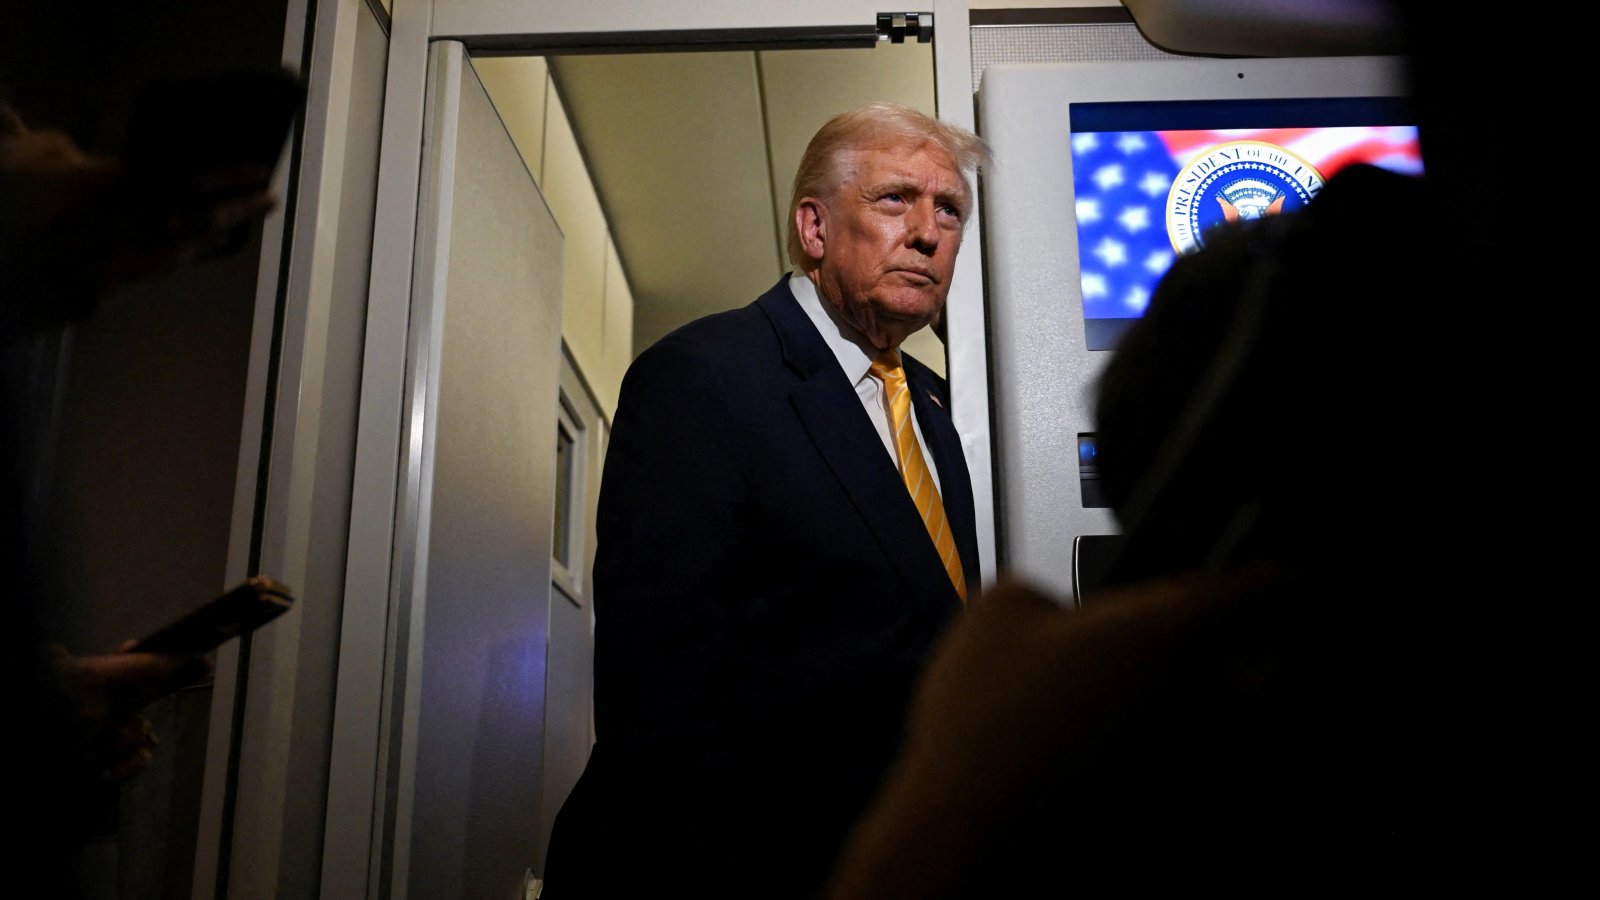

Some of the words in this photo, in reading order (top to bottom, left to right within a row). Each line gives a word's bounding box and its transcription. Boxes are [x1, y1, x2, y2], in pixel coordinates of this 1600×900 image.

[1174, 148, 1242, 216] PRESIDENT
[1247, 149, 1263, 158] OF
[1268, 152, 1289, 167] THE
[1294, 165, 1321, 195] UNI
